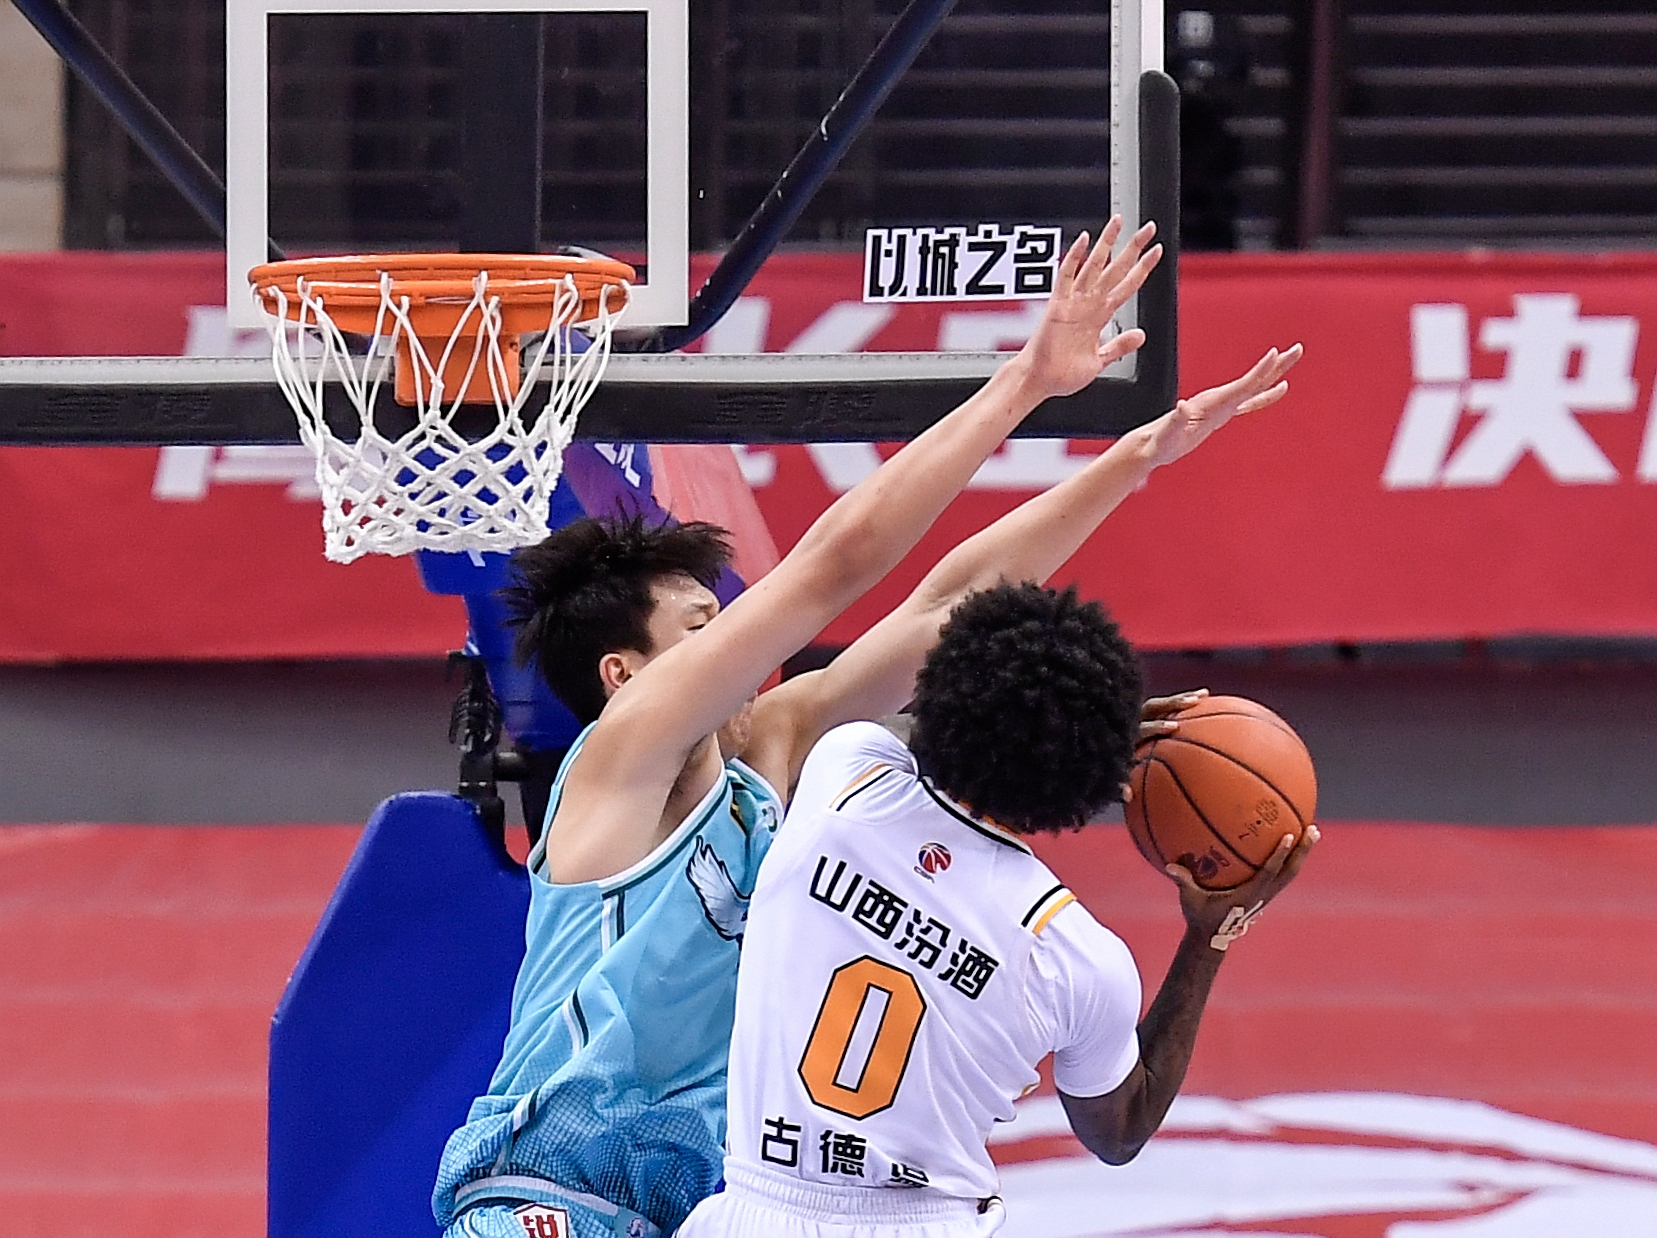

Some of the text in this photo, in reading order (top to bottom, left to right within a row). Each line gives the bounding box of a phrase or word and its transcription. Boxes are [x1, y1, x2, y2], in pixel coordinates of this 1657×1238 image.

[868, 229, 1056, 297] 以城之名
[1380, 293, 1657, 486] 决
[809, 855, 999, 1000] 山西汾酒
[797, 954, 927, 1121] 0
